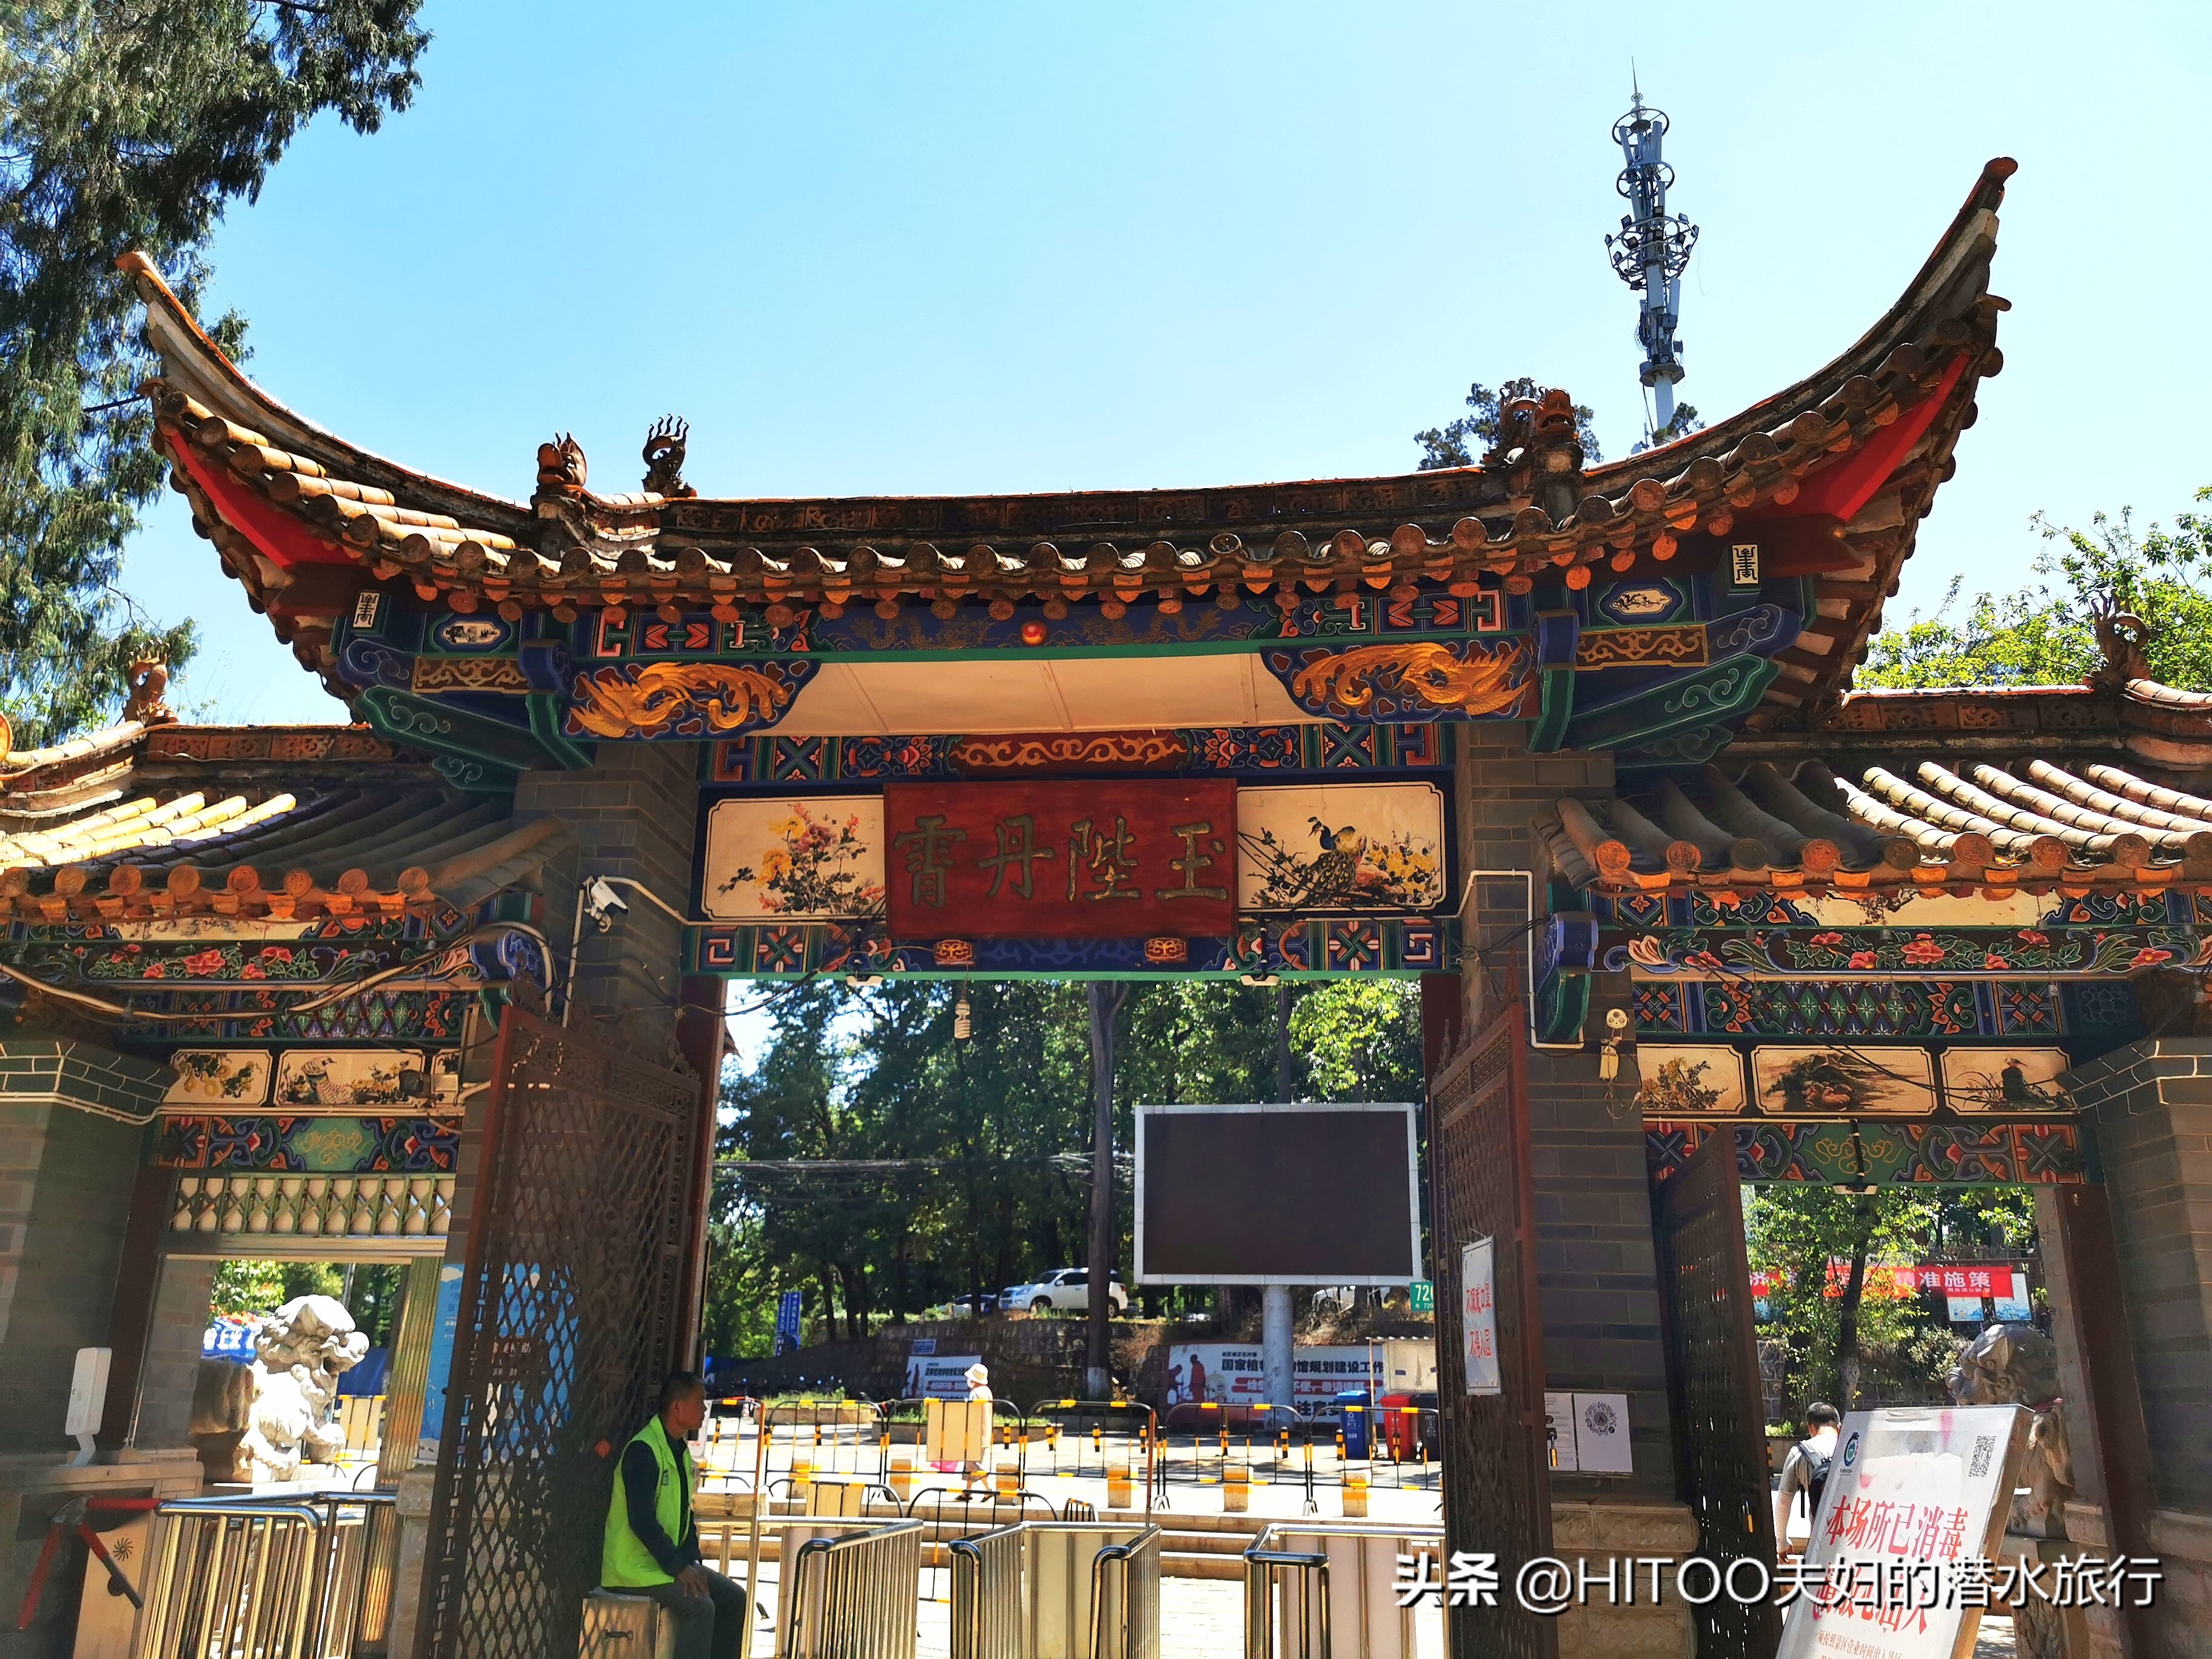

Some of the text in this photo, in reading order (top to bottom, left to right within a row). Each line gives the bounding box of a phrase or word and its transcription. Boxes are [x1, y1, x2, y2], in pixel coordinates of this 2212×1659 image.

[1825, 1495, 1969, 1562] 本场所已消毒
